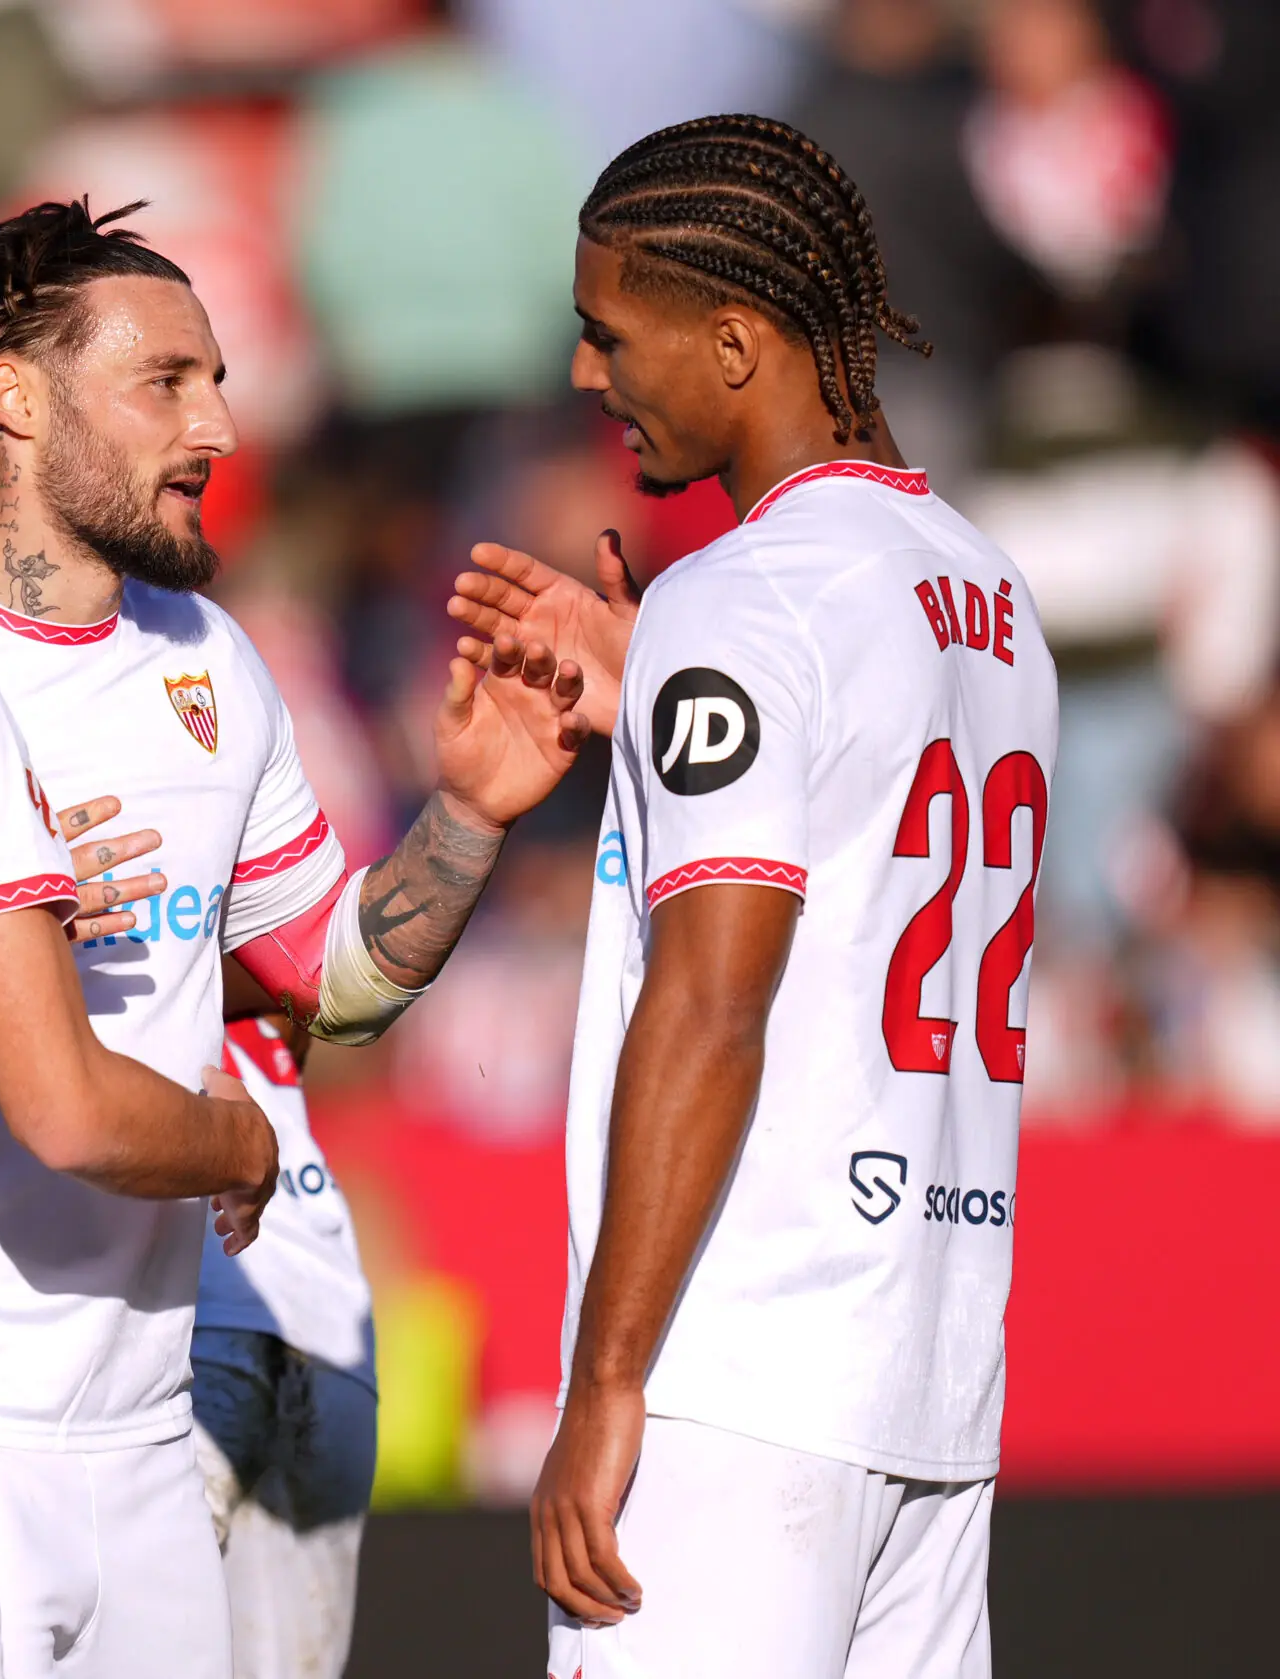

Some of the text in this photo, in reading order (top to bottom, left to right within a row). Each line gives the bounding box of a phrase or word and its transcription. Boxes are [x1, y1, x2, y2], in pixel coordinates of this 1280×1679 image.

[913, 575, 1014, 667] BADÉ
[661, 696, 746, 775] JD
[881, 737, 1048, 1085] 22
